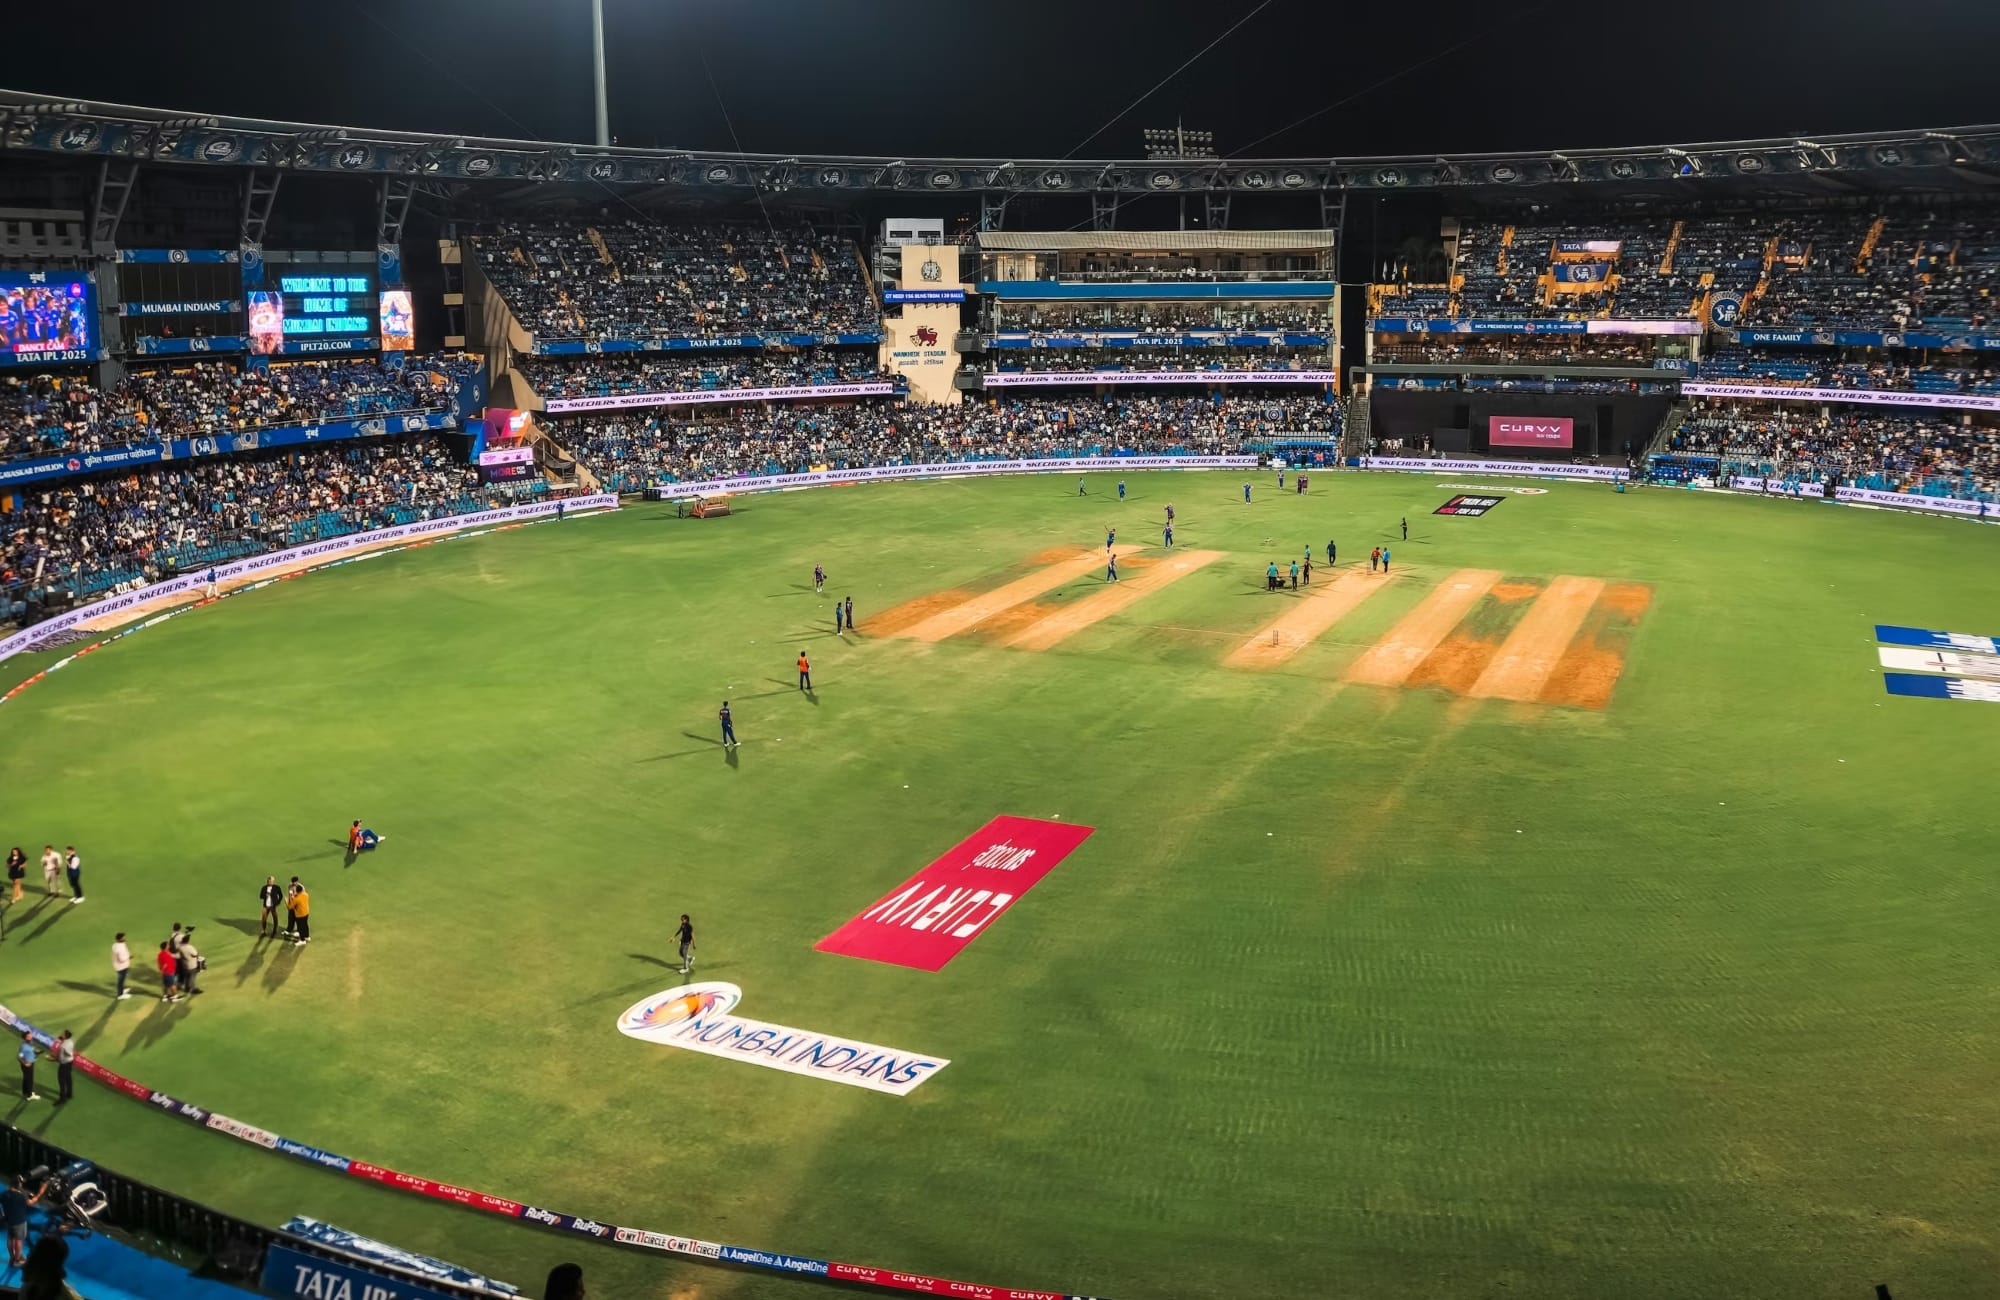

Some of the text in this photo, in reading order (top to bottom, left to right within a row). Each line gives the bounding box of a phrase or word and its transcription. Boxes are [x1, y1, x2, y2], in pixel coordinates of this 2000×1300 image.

[141, 302, 220, 313] MUMBAI INDIANS
[300, 341, 351, 351] IPLT20.COM
[689, 339, 708, 347] TATA
[722, 338, 742, 346] 2025
[15, 350, 87, 362] TATA IPL 2025
[568, 399, 616, 408] SKECHERS
[620, 396, 666, 405] SKECHERS
[670, 393, 716, 402] SKECHERS
[719, 390, 764, 399] SKECHERS
[768, 388, 812, 397] SKECHERS
[816, 386, 861, 394] SKECHERS
[1704, 387, 1756, 395] SKECHERS
[1761, 389, 1814, 397] SKECHERS
[1819, 391, 1872, 400] SKECHERS
[1877, 394, 1933, 402] SKECHERS
[1500, 424, 1560, 432] CURVV
[34, 463, 64, 474] PAVILION
[490, 466, 517, 477] MORE
[1484, 463, 1533, 471] SKECHERS
[1538, 466, 1589, 474] SKECHERS
[673, 483, 721, 494] SKECHERS
[724, 479, 772, 489] SKECHERS
[776, 474, 822, 484] SKECHERS
[826, 471, 872, 479] SKECHERS
[876, 467, 922, 476] SKECHERS
[926, 464, 972, 473] SKECHERS
[1870, 493, 1926, 505] SKECHERS
[31, 614, 77, 638] SKECHERS
[82, 597, 134, 619] SKECHERS
[138, 580, 189, 599] SKECHERS
[247, 552, 296, 570] SKECHERS
[300, 540, 349, 558] SKECHERS
[354, 529, 404, 545] SKECHERS
[408, 519, 459, 535] SKECHERS
[463, 510, 512, 525] SKECHERS
[569, 496, 614, 508] SKECHERS
[862, 880, 1013, 938] CURVV
[677, 1006, 937, 1084] MUMBAI INDIANS
[355, 1163, 386, 1176] CURVV
[395, 1174, 428, 1187] CURVV
[438, 1185, 471, 1198] CURVV
[482, 1196, 516, 1209] CURVV
[525, 1207, 556, 1226] RuPay
[572, 1218, 604, 1237] RuPay
[836, 1265, 878, 1277] CURVV
[294, 1264, 351, 1300] TATA
[892, 1274, 935, 1286] CURVV
[950, 1283, 993, 1294] CURVV
[1010, 1291, 1054, 1300] CURVV
